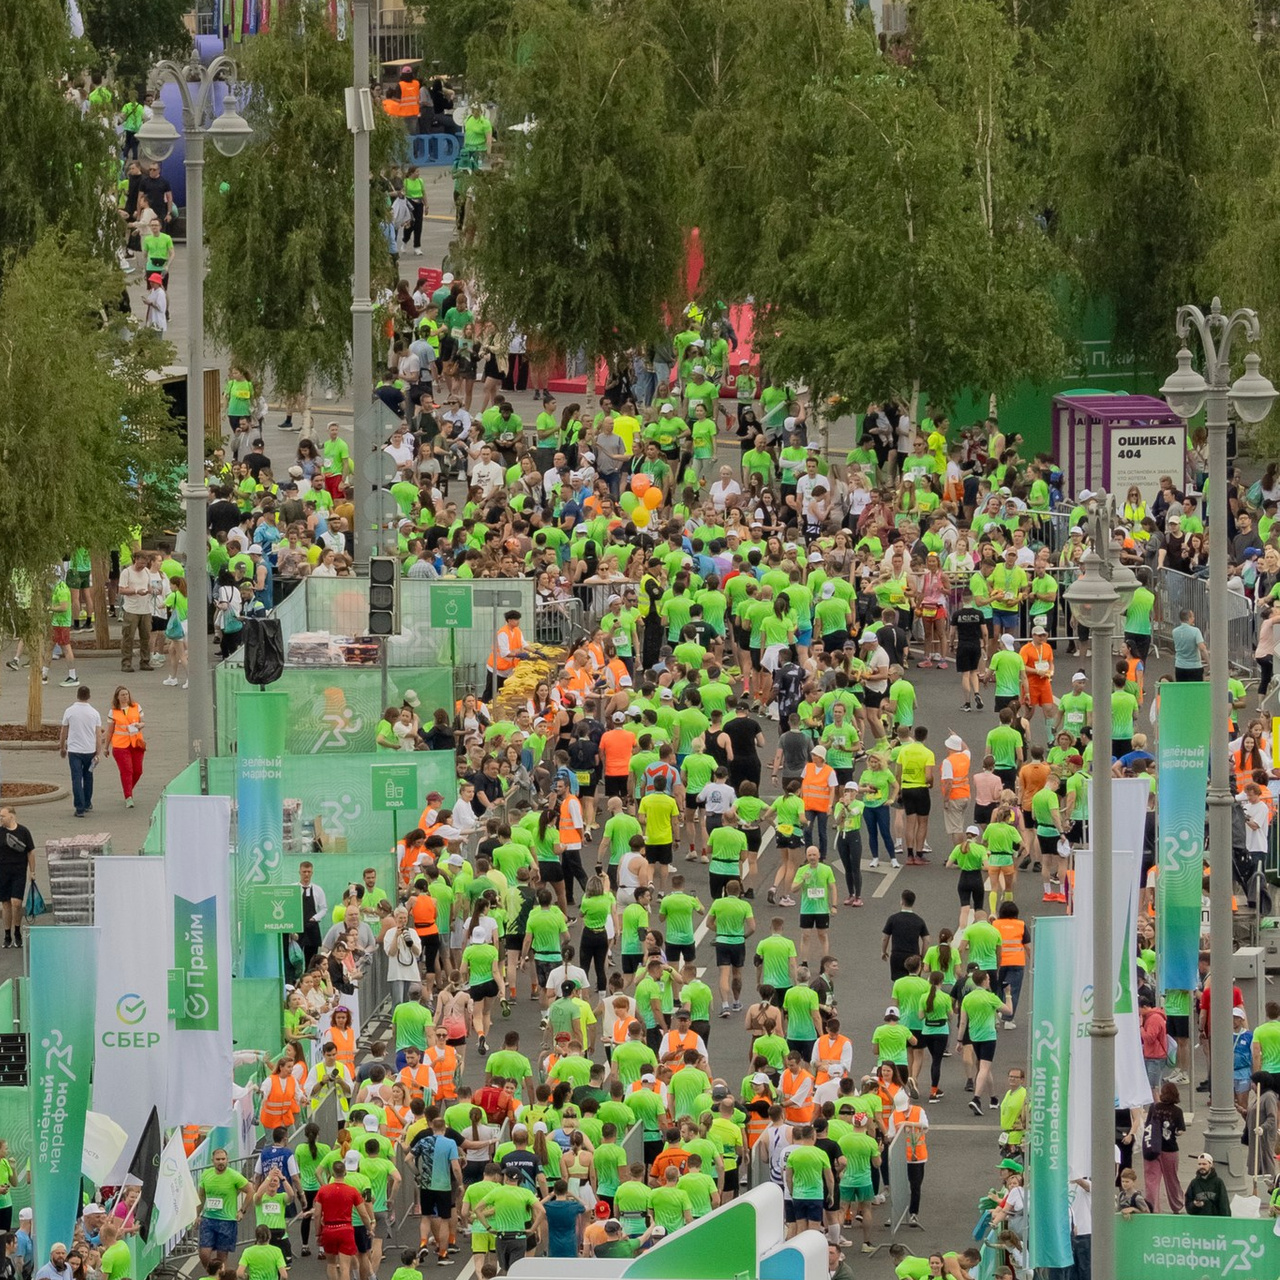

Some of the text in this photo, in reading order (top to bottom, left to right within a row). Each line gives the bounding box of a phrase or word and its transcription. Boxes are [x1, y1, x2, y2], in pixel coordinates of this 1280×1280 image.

[1117, 435, 1176, 446] ОШИБКА
[1117, 449, 1142, 459] 404
[957, 614, 980, 623] ASICS
[264, 922, 294, 930] МЕДАЛИ
[184, 913, 208, 988] Прайм
[101, 1030, 161, 1049] СБЕР
[36, 1074, 55, 1164] зелёный
[49, 1081, 69, 1173] марафон
[1047, 1075, 1061, 1171] марафон
[1152, 1232, 1228, 1251] зелёный
[1143, 1251, 1220, 1270] марафон
